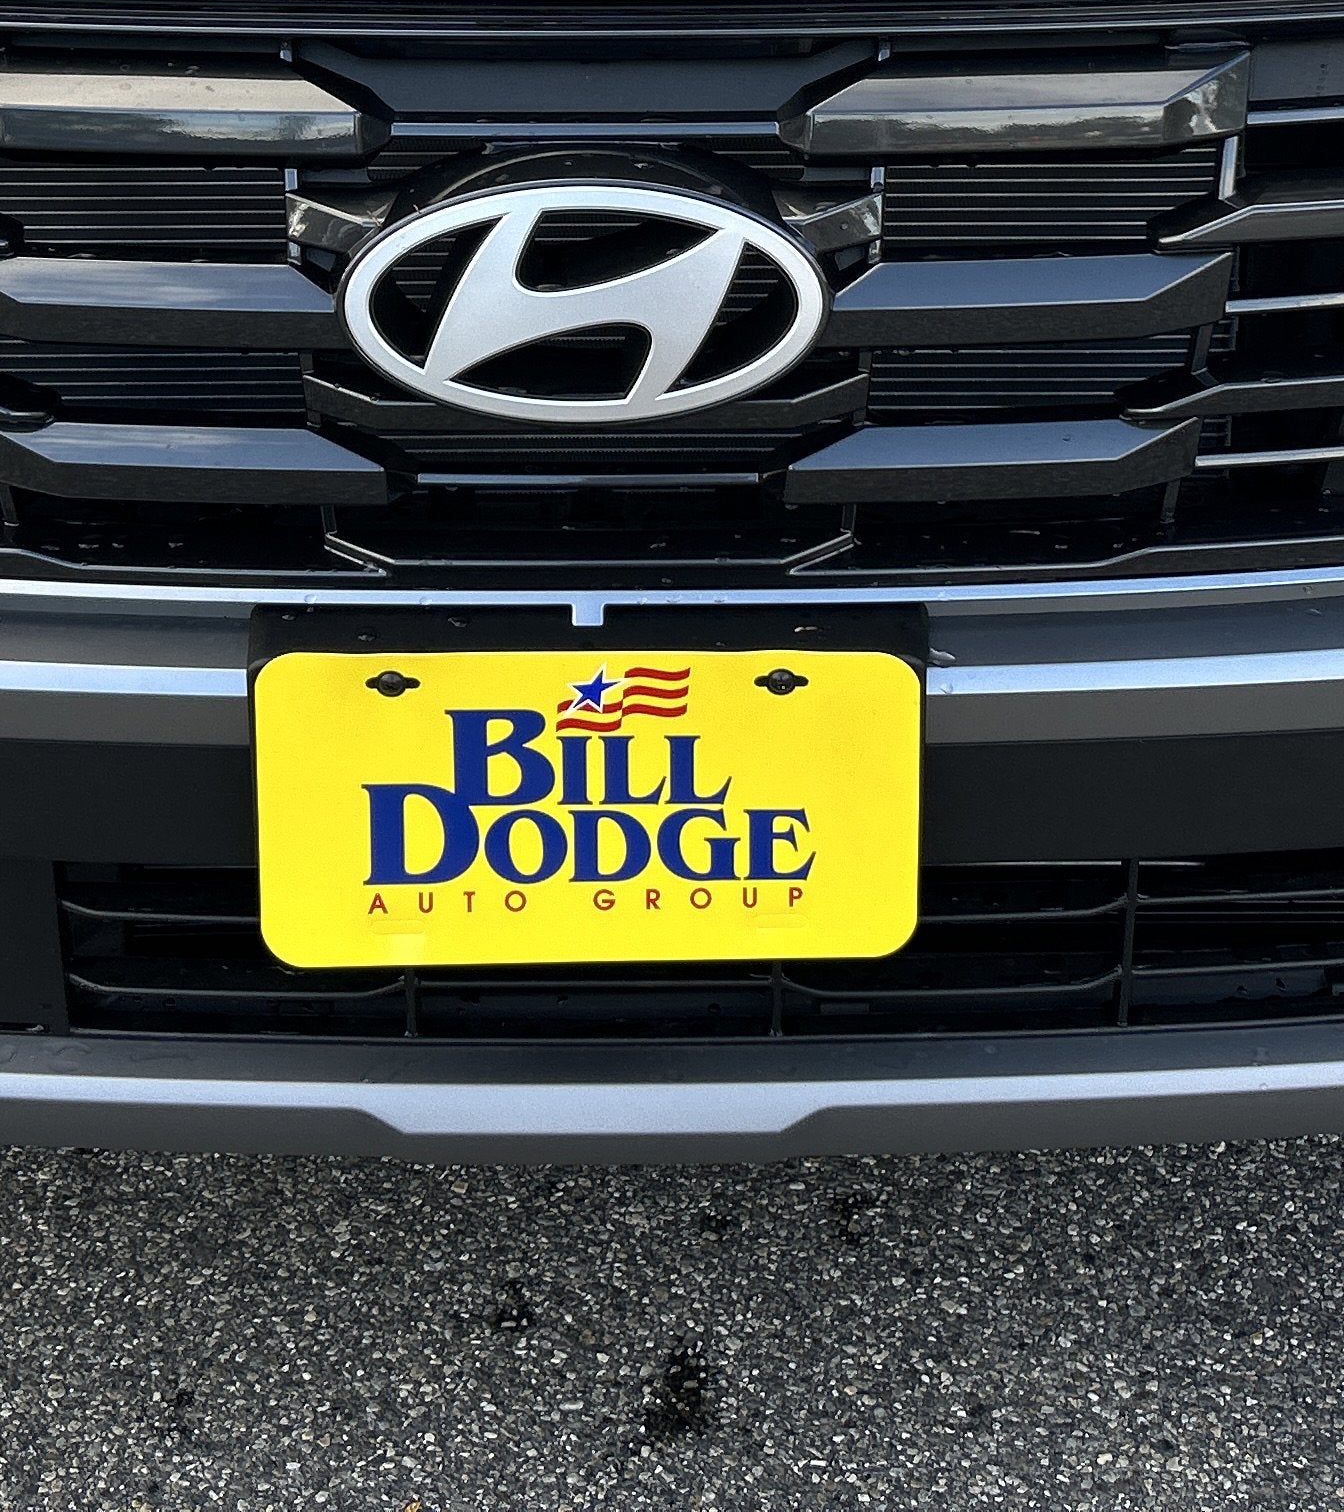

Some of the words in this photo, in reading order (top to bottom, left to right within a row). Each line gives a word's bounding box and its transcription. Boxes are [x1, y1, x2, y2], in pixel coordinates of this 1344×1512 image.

[445, 710, 732, 806] BILL
[361, 784, 816, 886] DODGE
[367, 890, 528, 915] AUTO
[593, 887, 805, 912] GROUP
